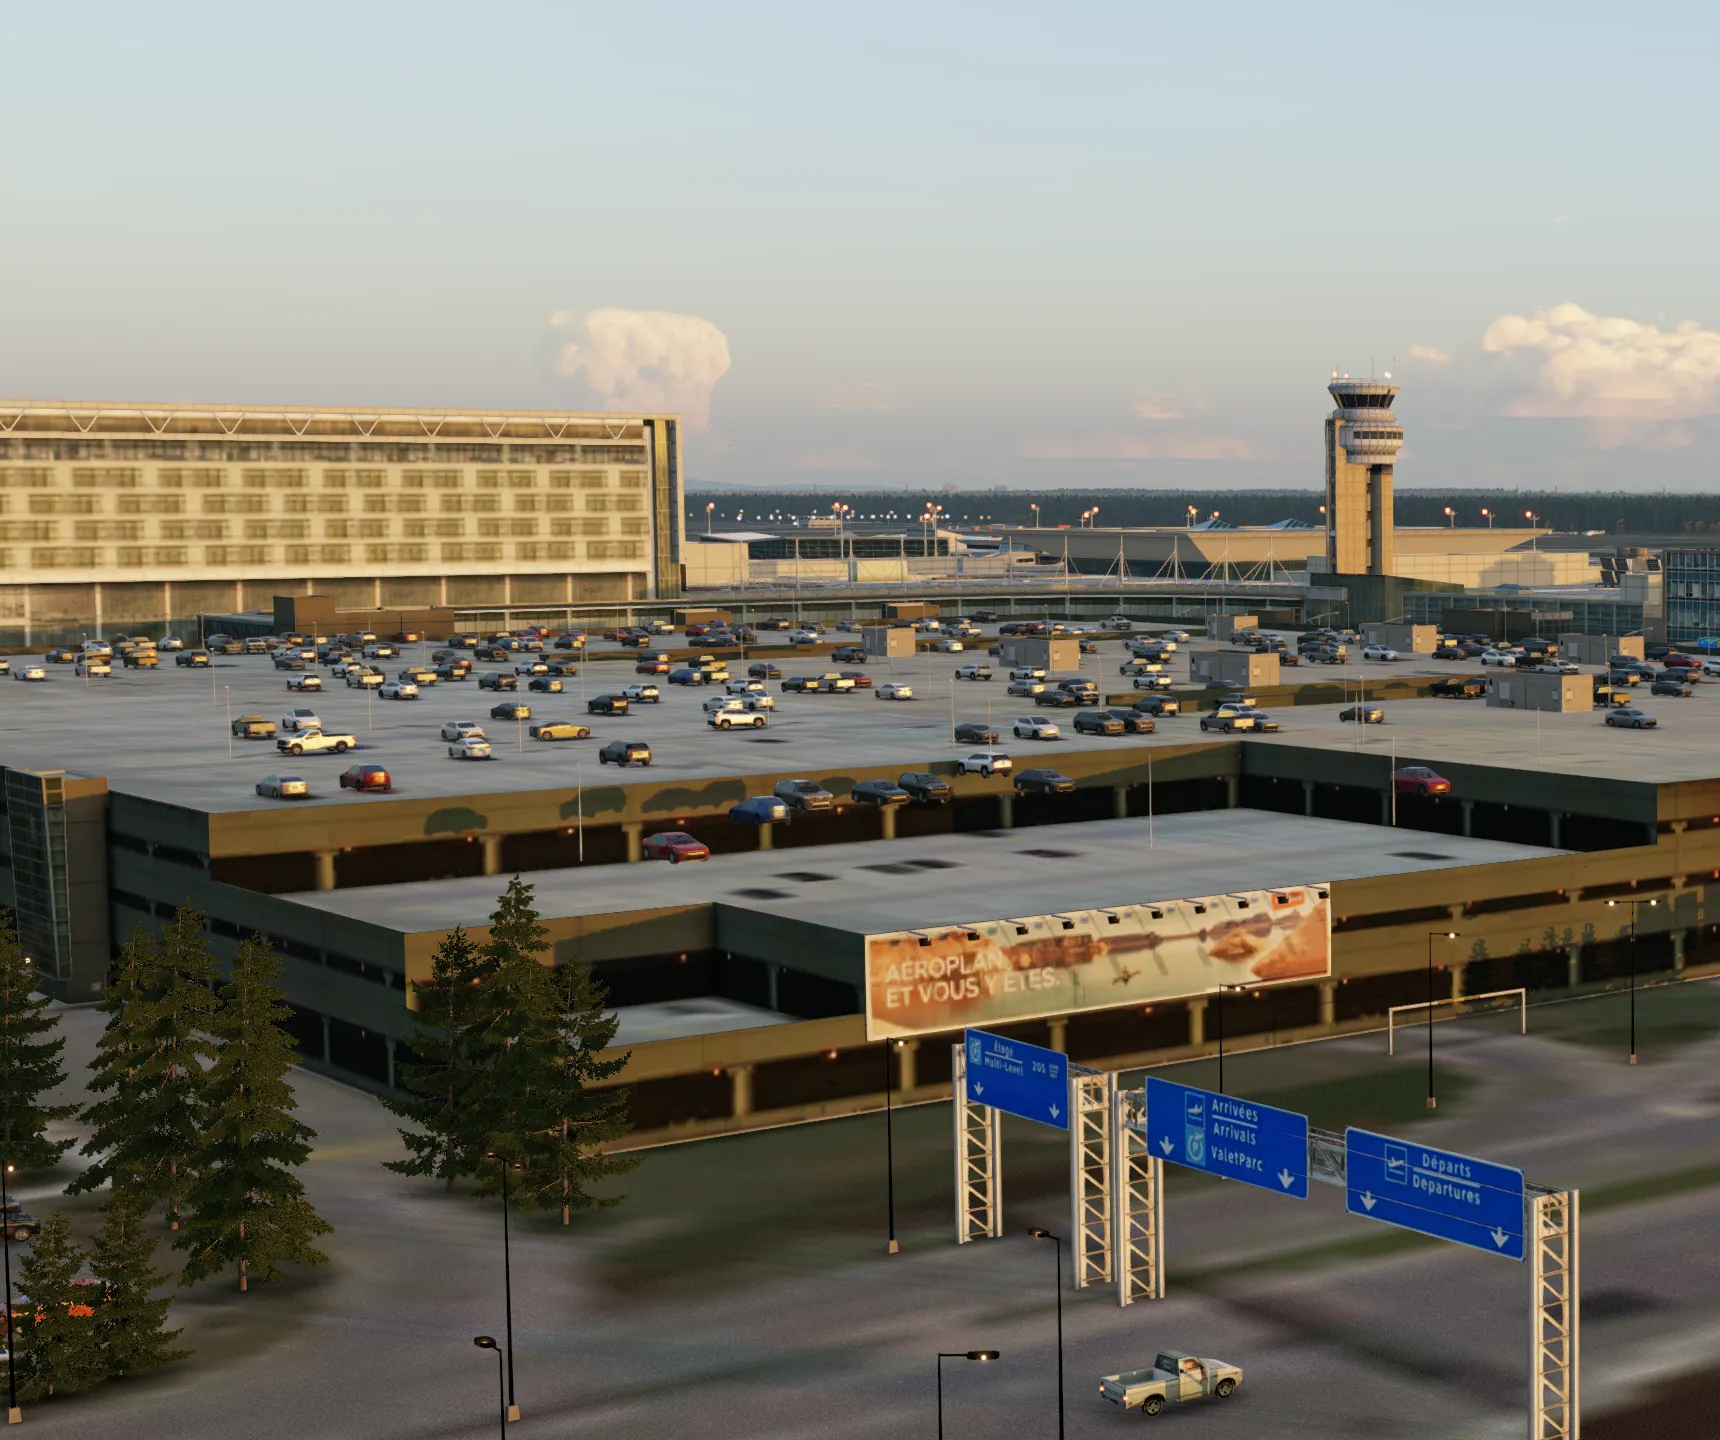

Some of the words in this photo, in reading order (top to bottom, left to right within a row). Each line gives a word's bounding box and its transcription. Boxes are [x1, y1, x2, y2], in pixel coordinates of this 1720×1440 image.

[886, 987, 913, 1008] ET
[918, 977, 980, 1003] VOUS
[984, 973, 997, 996] Y
[984, 1056, 1024, 1077] Multi-Level
[1211, 1098, 1258, 1122] Arrivées
[1213, 1121, 1256, 1146] Arrivals
[1211, 1145, 1263, 1172] ValetParc
[1422, 1153, 1471, 1178] Départs
[1412, 1174, 1480, 1205] Departures
